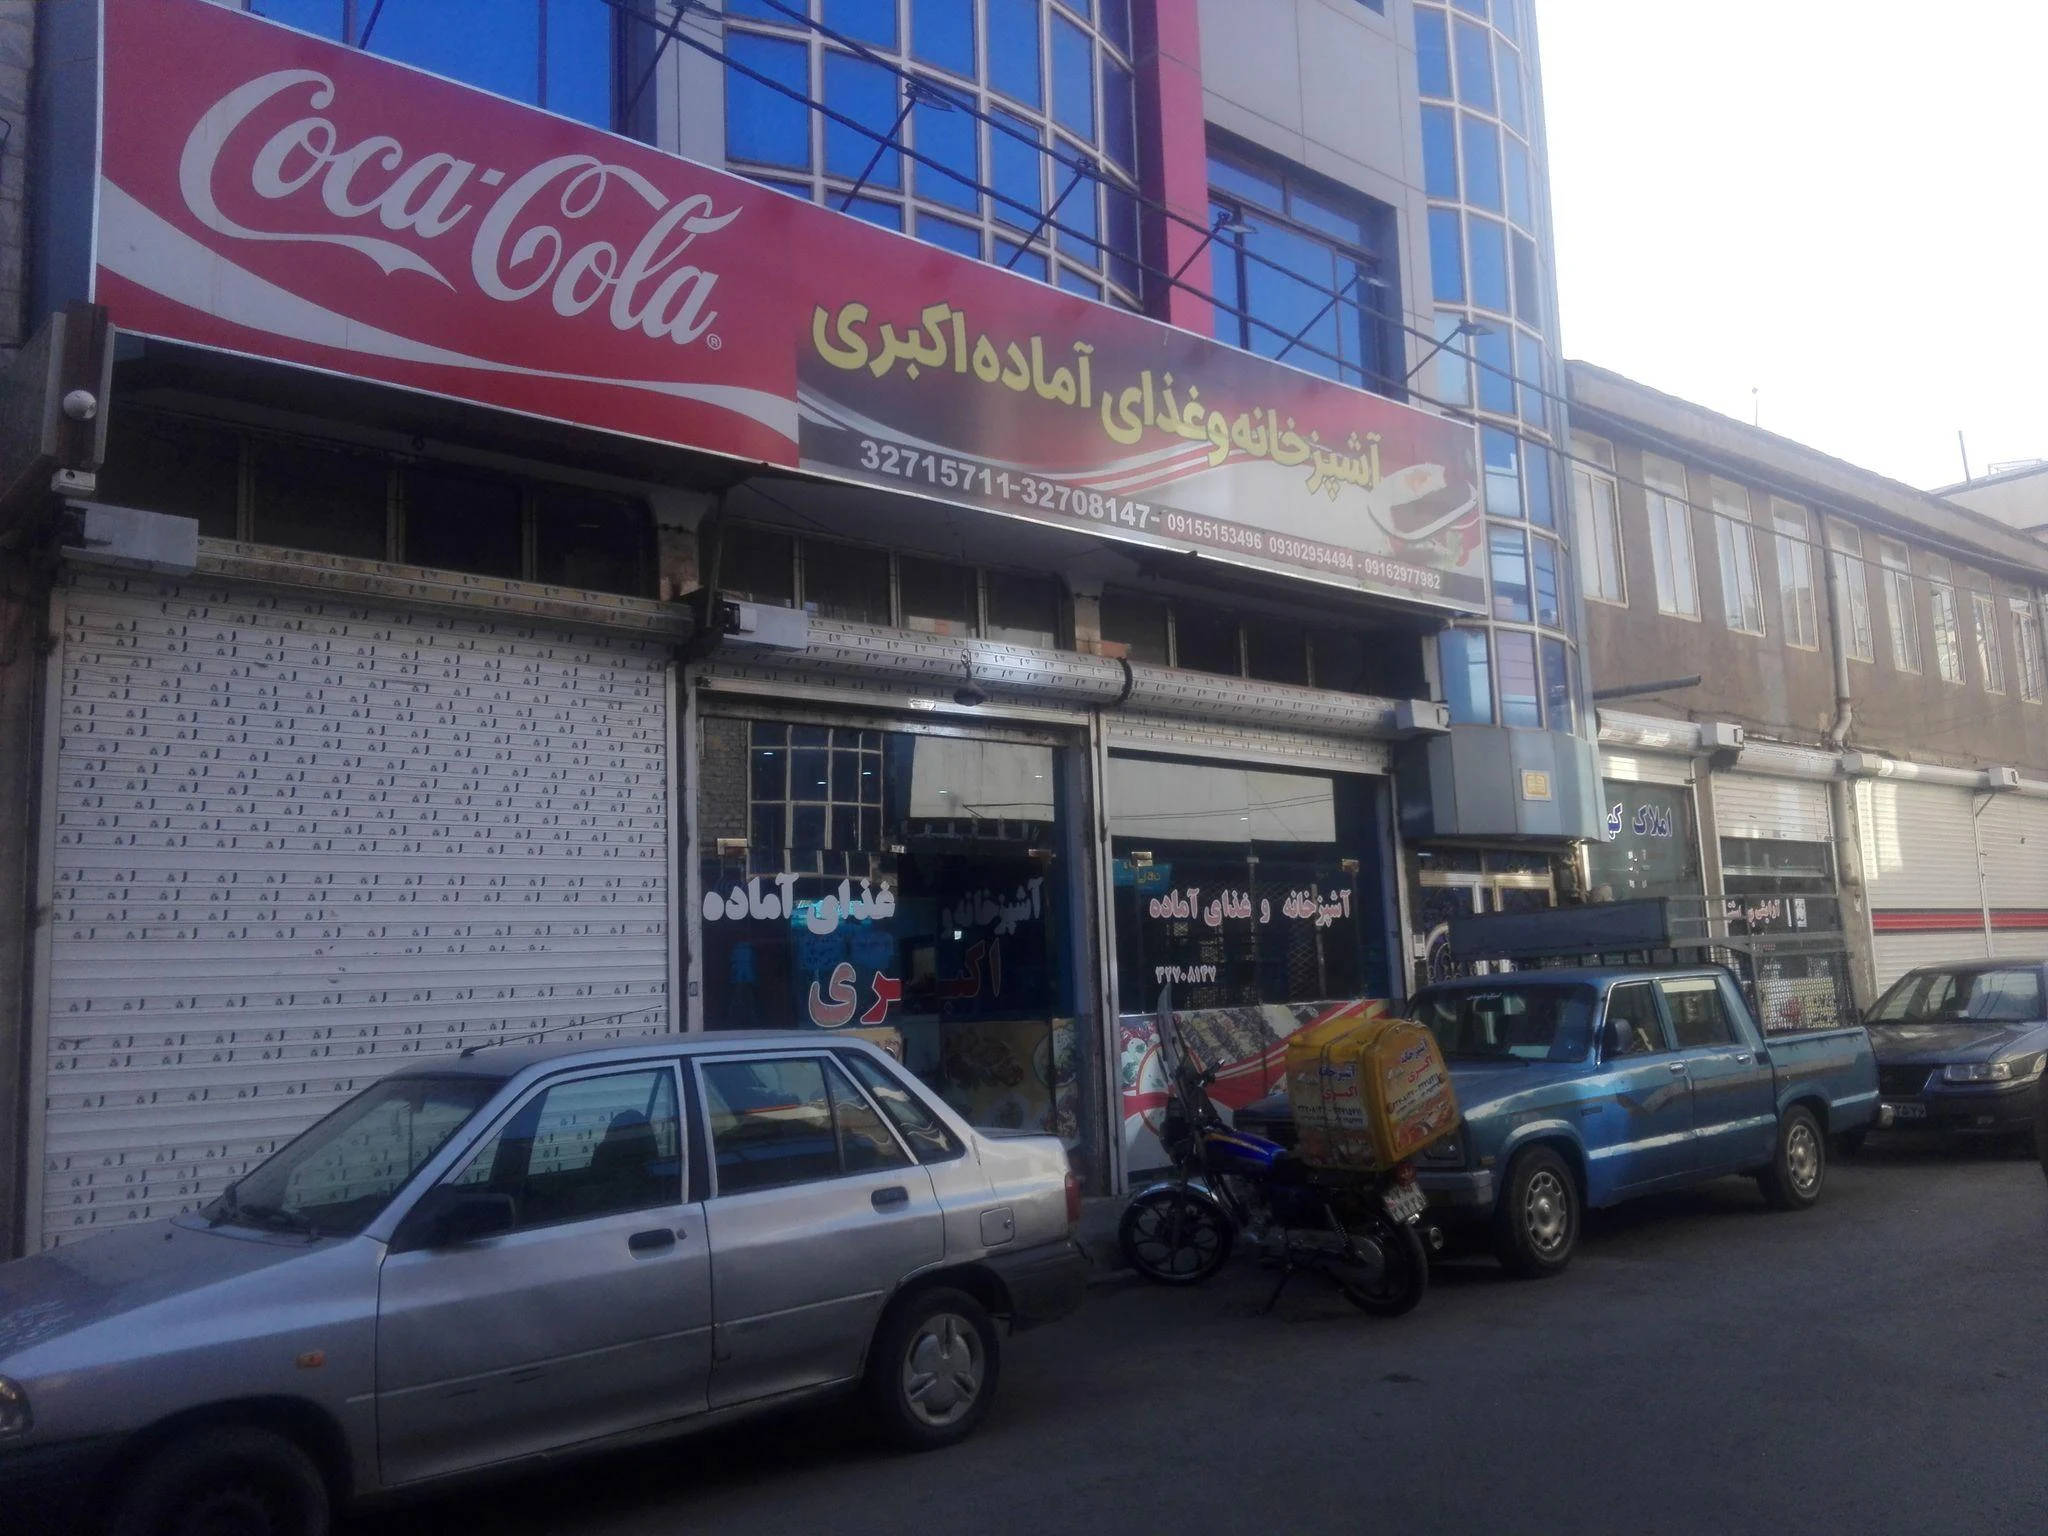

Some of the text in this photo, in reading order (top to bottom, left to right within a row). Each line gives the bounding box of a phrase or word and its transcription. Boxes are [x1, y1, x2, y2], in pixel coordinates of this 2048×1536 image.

[179, 69, 743, 346] Coca-Cola
[702, 872, 800, 921] آماده
[1149, 887, 1200, 919] آماده
